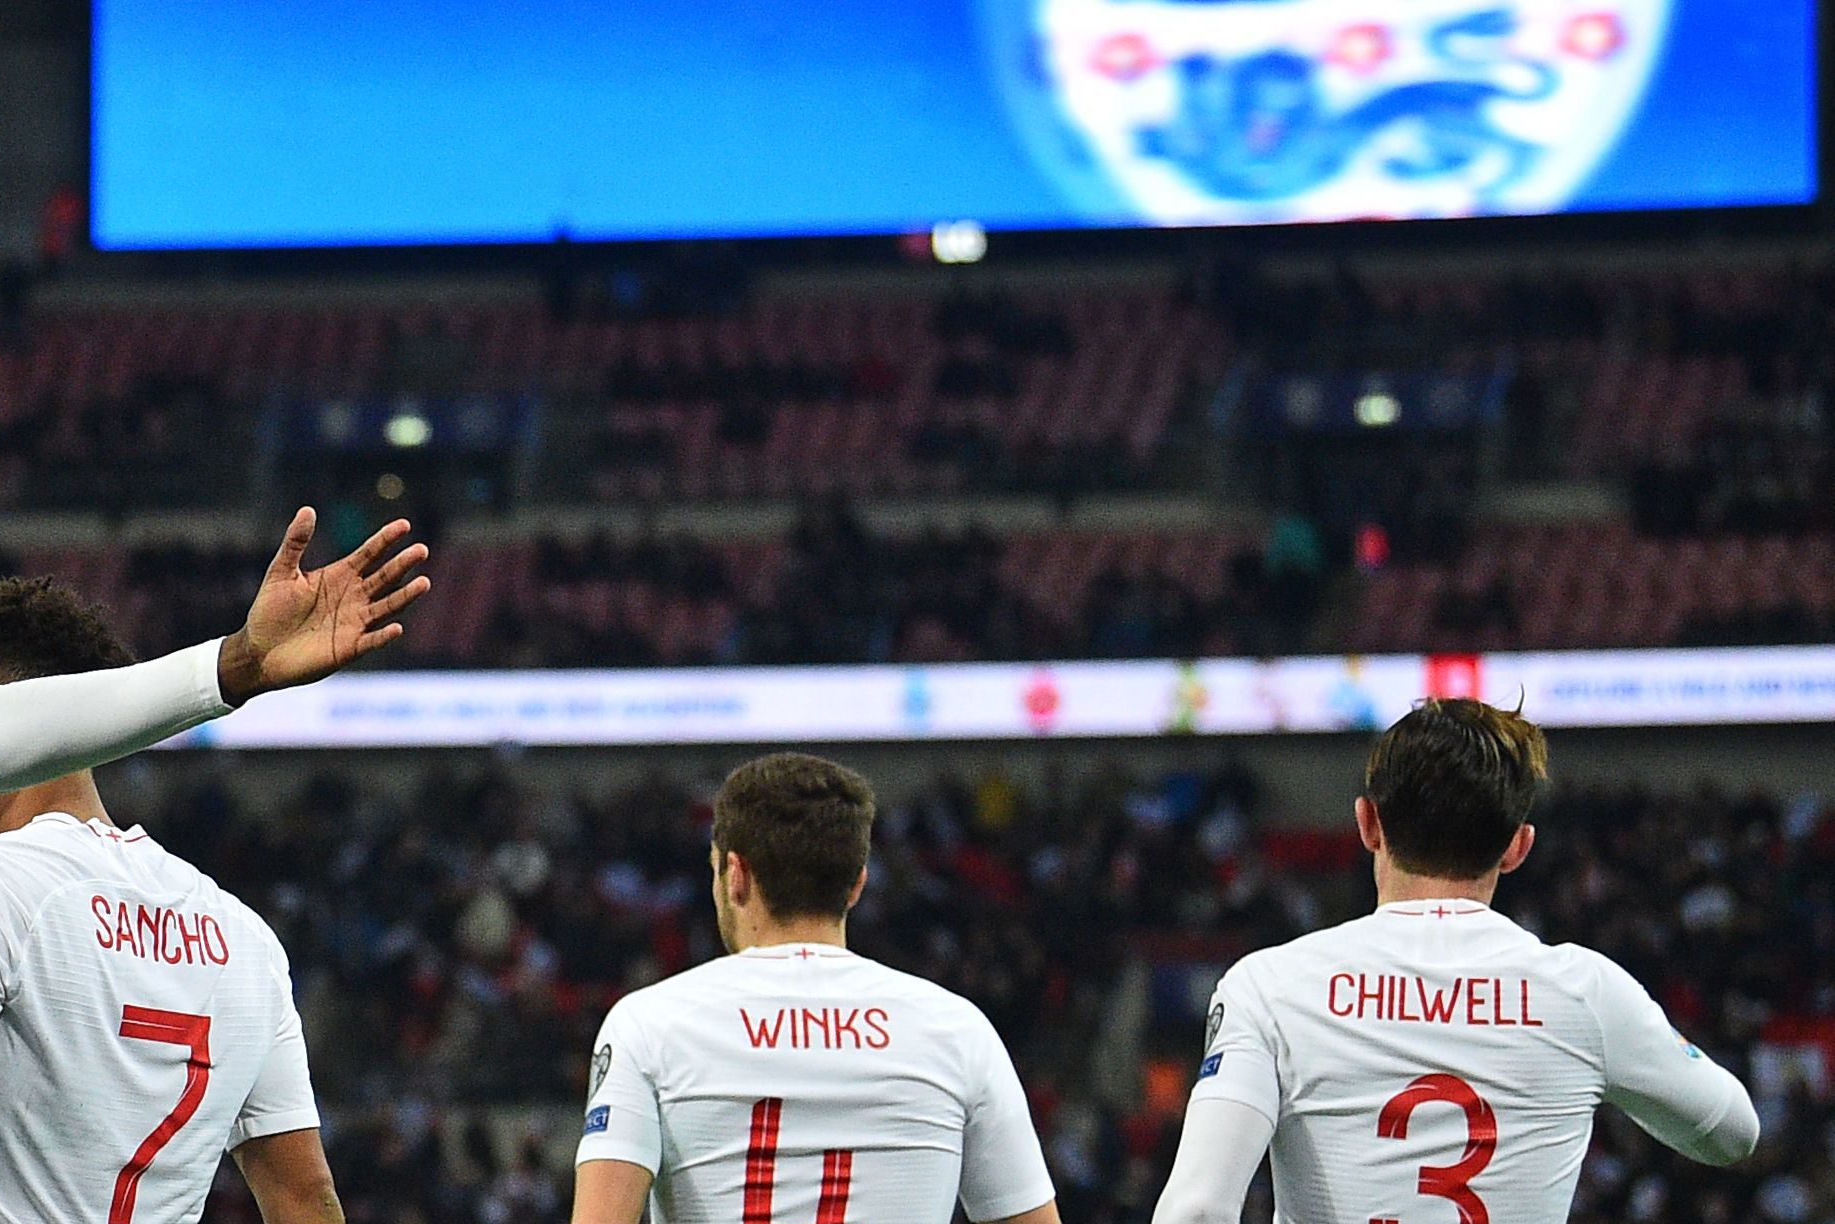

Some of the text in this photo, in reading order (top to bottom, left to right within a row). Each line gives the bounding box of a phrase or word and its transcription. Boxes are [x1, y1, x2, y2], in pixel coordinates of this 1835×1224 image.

[91, 895, 230, 966] SANCHO
[1328, 973, 1543, 1027] CHILWELL
[740, 1008, 890, 1050] WINKS
